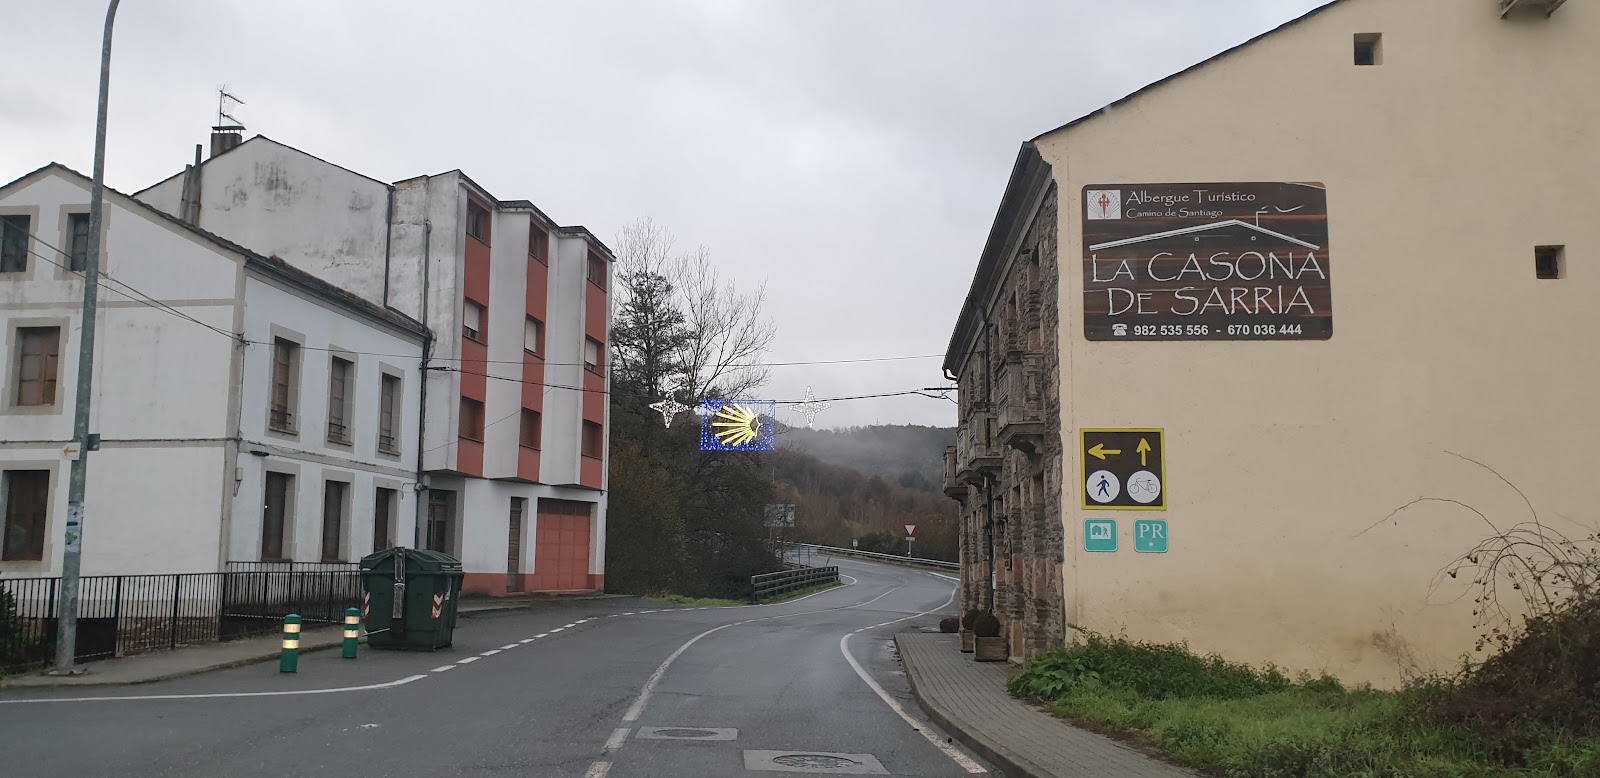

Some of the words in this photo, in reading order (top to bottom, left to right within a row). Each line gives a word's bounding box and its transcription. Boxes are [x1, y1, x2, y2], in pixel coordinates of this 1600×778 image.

[1126, 190, 1189, 206] Albergue
[1193, 189, 1256, 204] Turístico
[1126, 208, 1163, 219] Camino
[1165, 207, 1176, 217] de
[1178, 207, 1223, 219] Santiago
[1091, 253, 1135, 283] LA
[1147, 251, 1326, 282] CASONA
[1107, 287, 1159, 316] DE
[1170, 285, 1315, 316] SARRIA
[1133, 324, 1157, 336] 982
[1160, 324, 1183, 336] 535
[1186, 324, 1209, 336] 556
[1227, 324, 1250, 335] 670
[1253, 324, 1276, 335] 036
[1279, 324, 1302, 335] 444
[1139, 523, 1165, 539] PR
